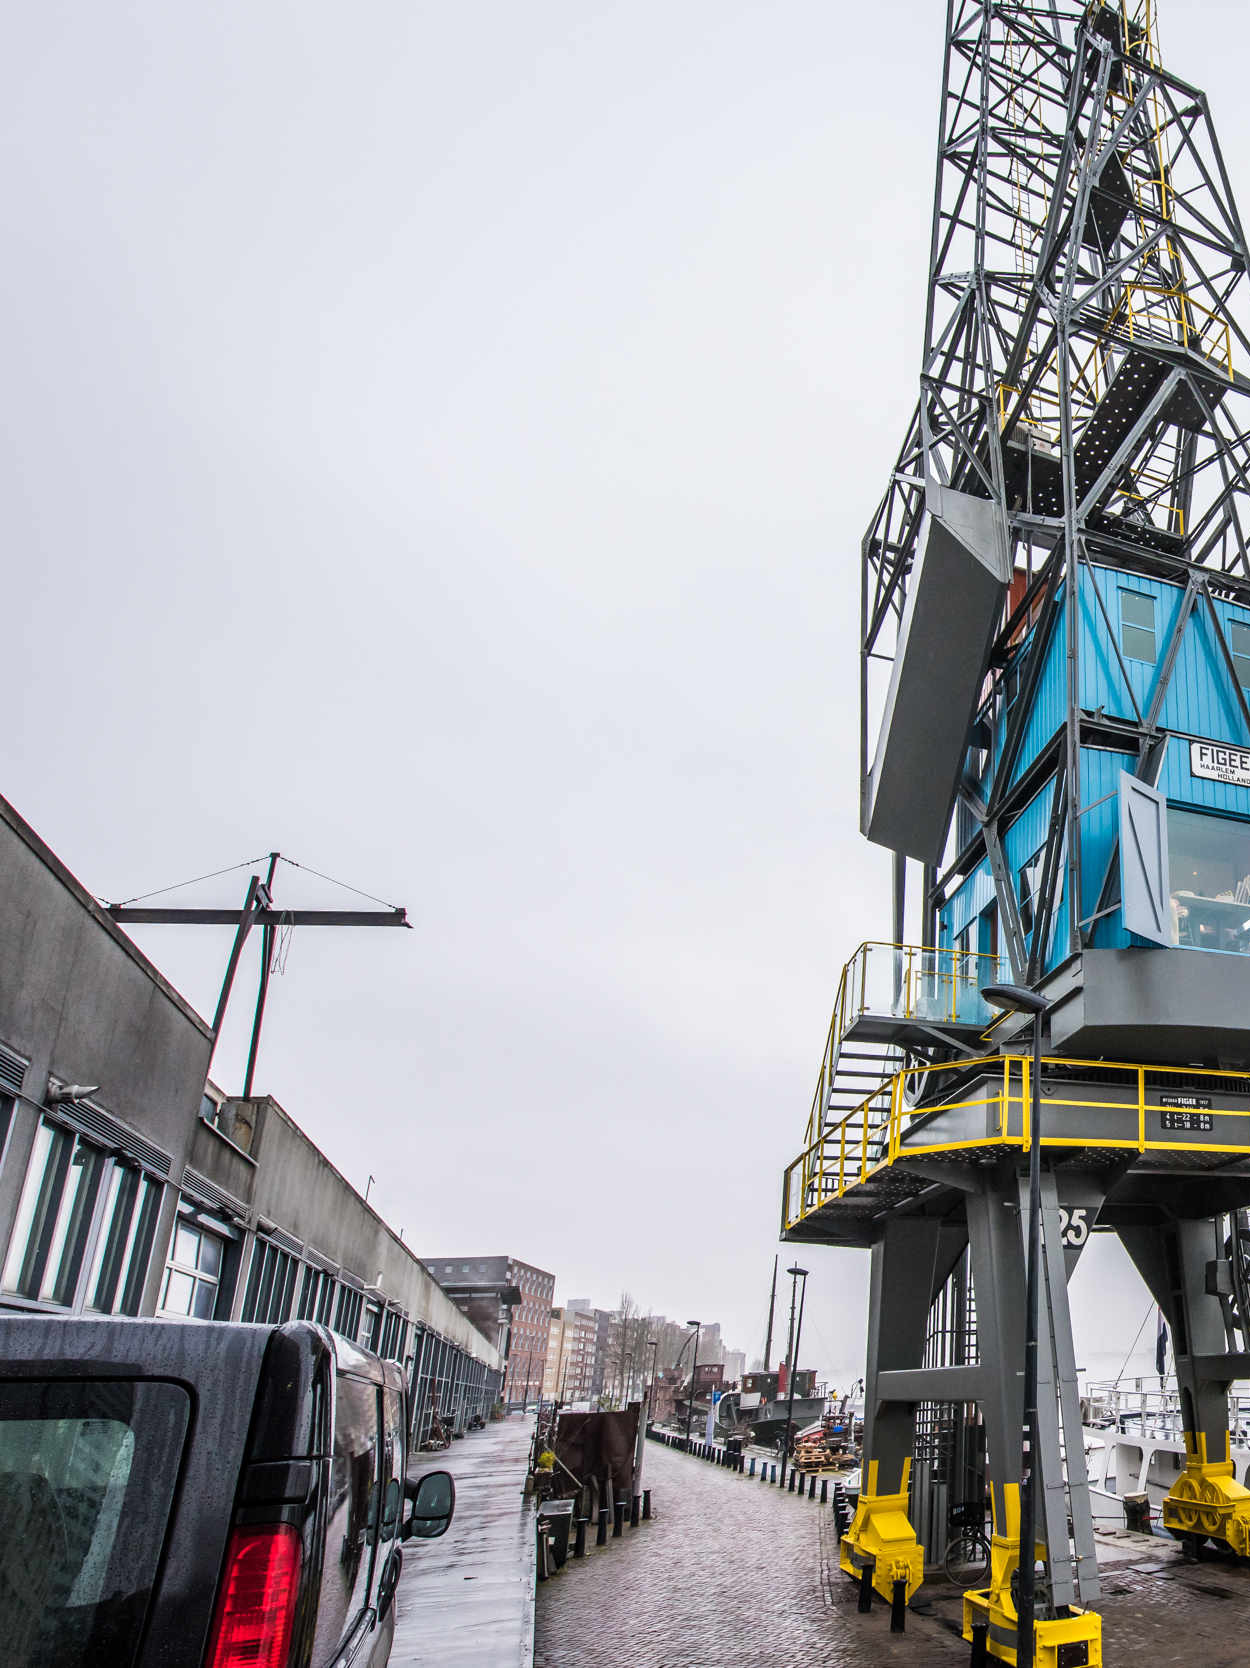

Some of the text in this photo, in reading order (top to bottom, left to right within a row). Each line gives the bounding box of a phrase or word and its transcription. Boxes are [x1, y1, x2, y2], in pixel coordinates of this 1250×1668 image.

[1200, 746, 1250, 771] FIGEE
[1200, 763, 1235, 775] HAARLEM
[1217, 773, 1250, 784] HOLLAND
[1178, 1097, 1197, 1105] FIGEE
